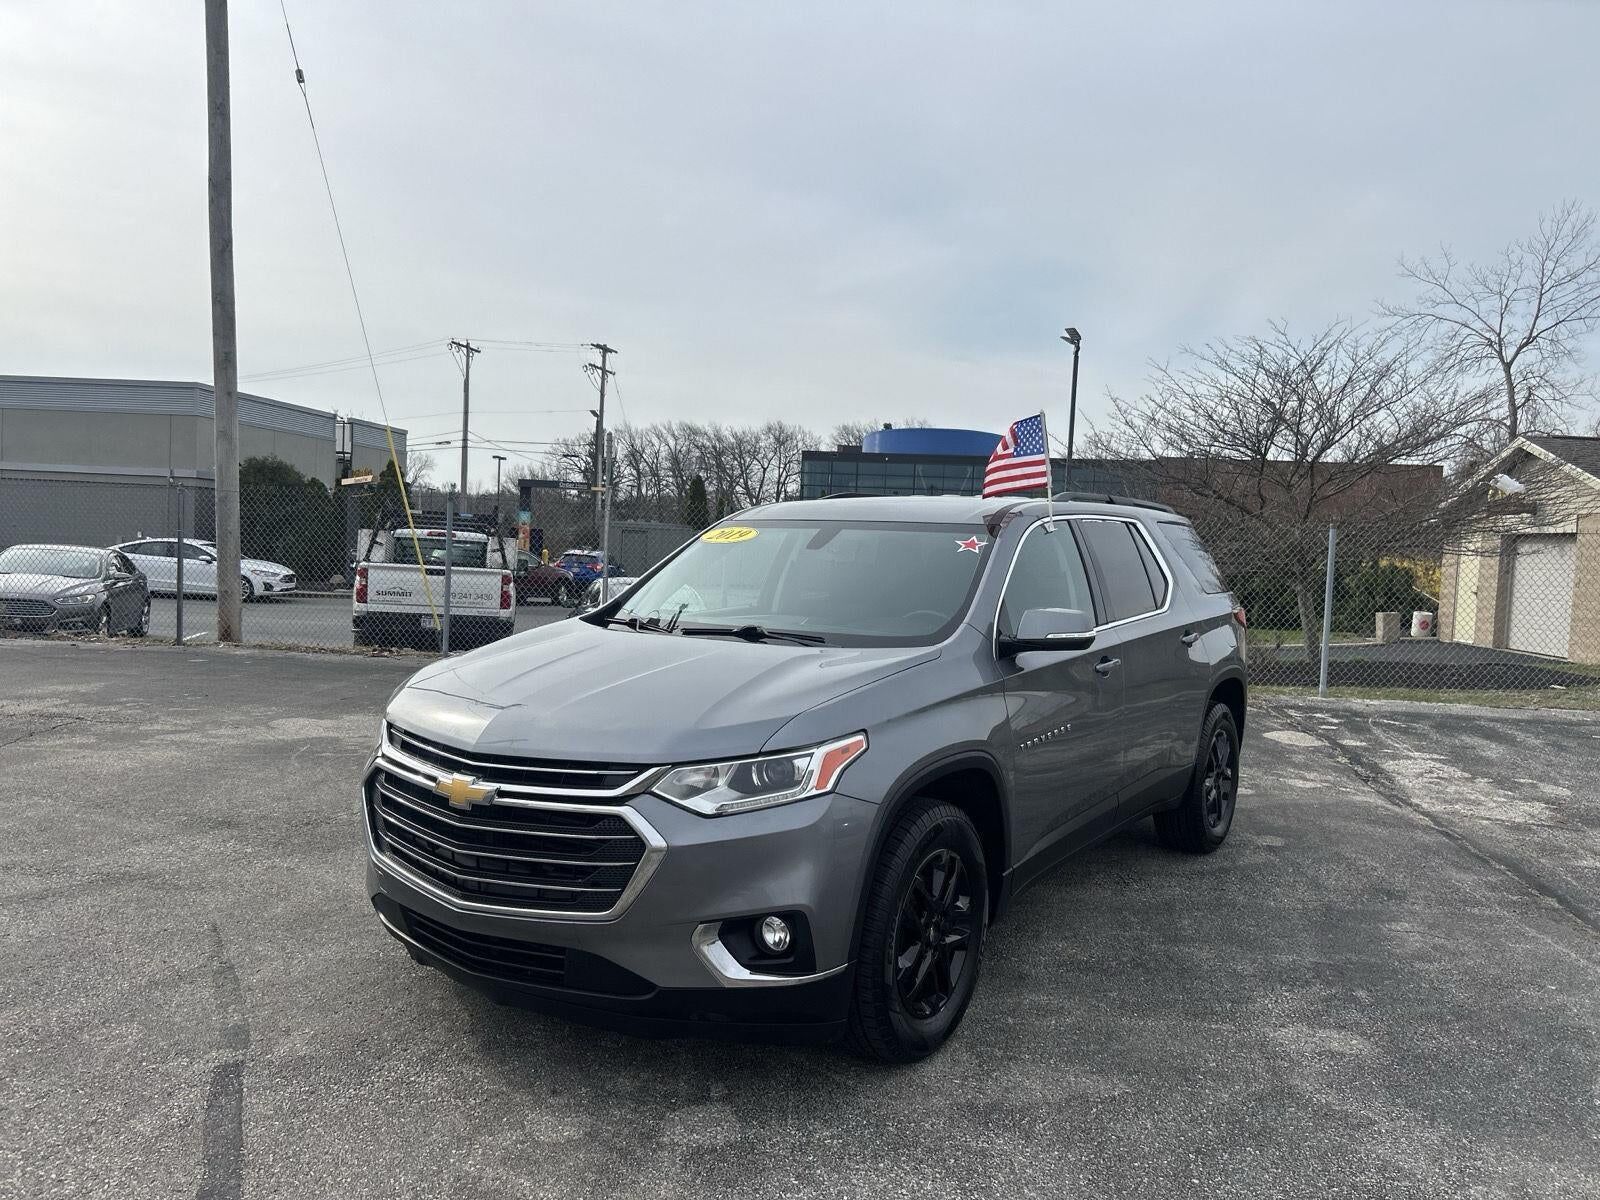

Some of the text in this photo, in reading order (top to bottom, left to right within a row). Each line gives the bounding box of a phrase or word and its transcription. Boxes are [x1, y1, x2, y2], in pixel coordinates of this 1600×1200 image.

[705, 529, 753, 540] 2019
[375, 590, 413, 598] SUMMIT
[457, 592, 472, 600] 241
[474, 593, 493, 601] 3430
